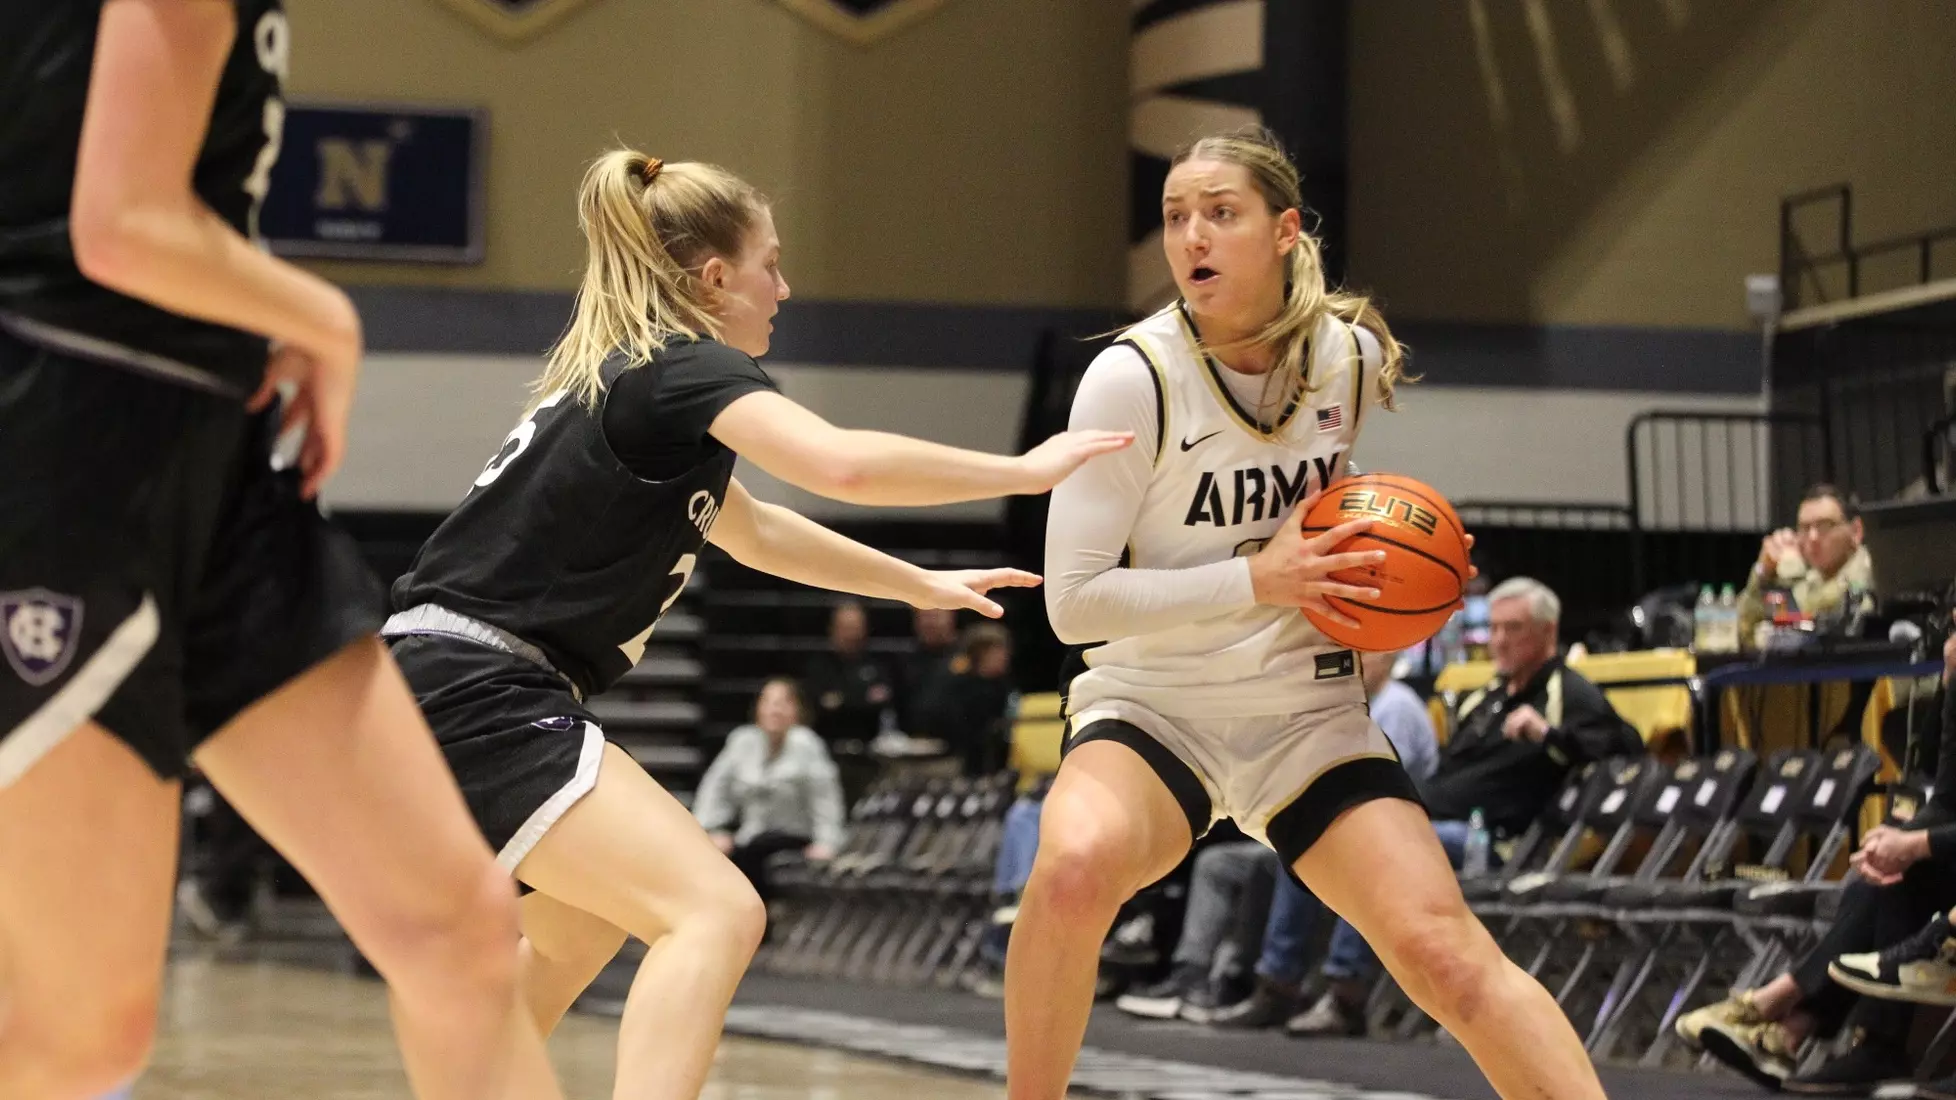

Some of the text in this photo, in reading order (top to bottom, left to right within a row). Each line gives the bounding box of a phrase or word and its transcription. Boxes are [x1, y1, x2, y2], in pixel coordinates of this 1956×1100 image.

[315, 138, 391, 209] N
[1184, 452, 1339, 527] ARMY
[1338, 490, 1438, 536] ELITE
